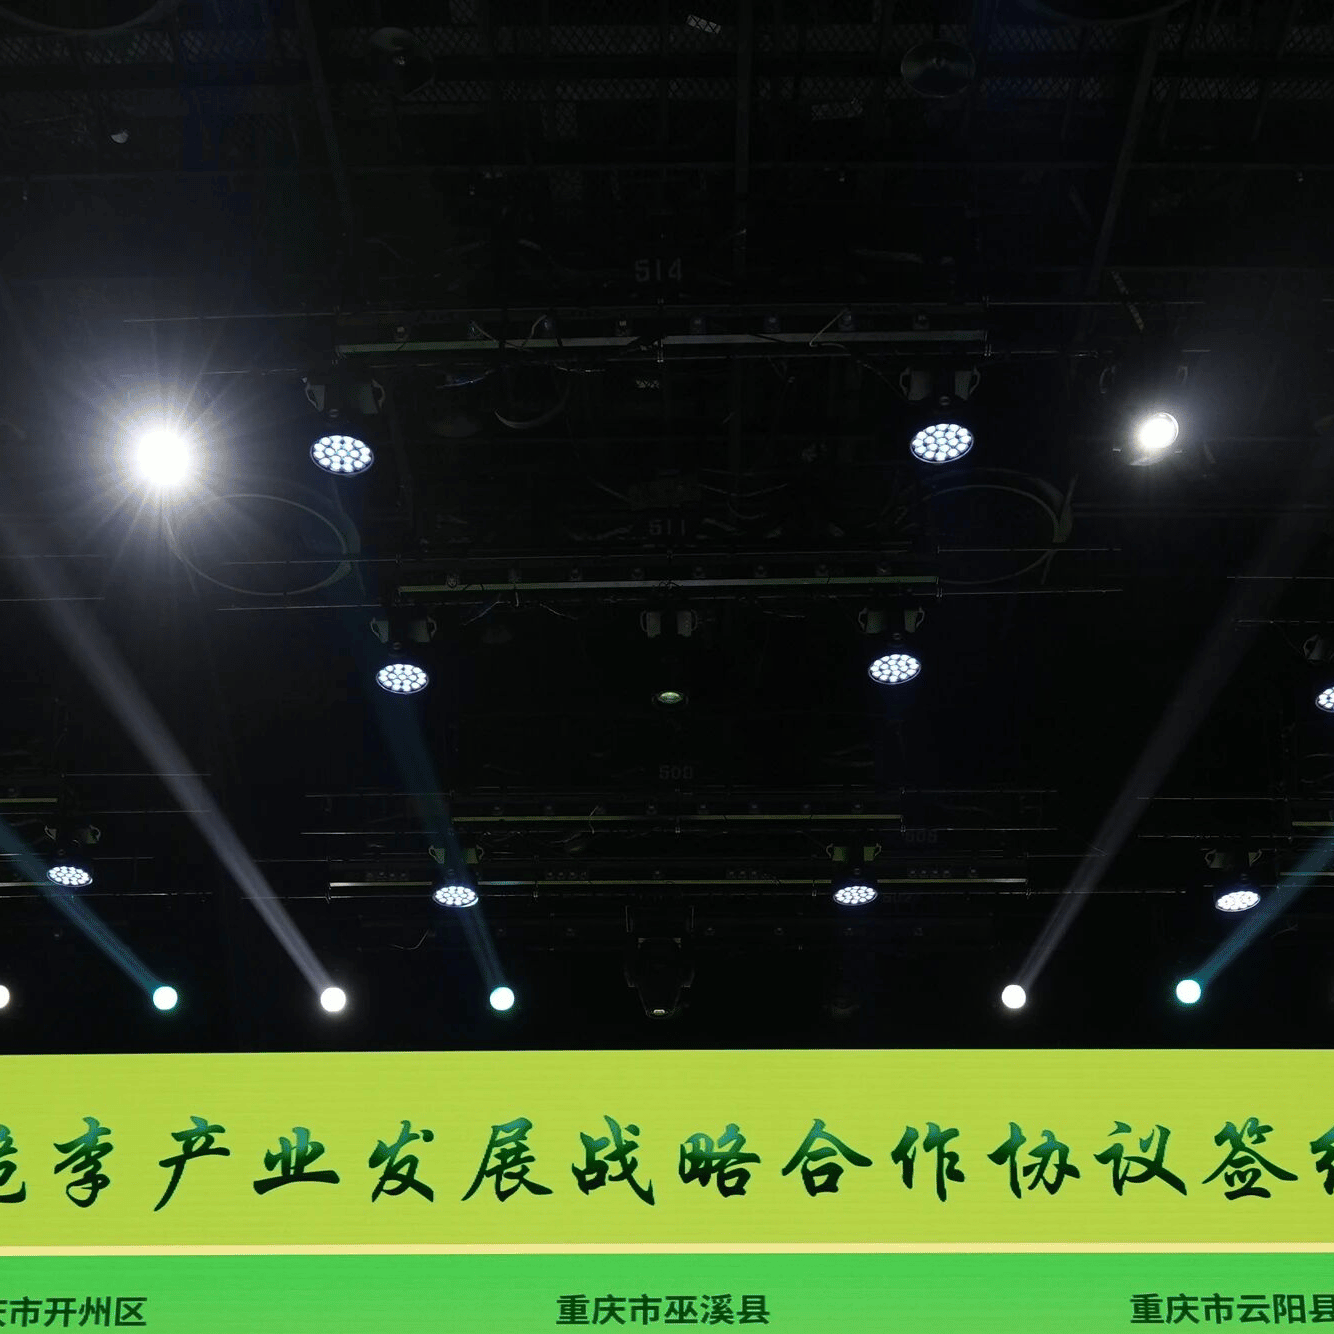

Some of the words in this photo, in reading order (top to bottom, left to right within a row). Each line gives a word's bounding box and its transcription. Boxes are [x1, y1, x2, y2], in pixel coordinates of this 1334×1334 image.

[634, 257, 683, 283] 514
[556, 1293, 770, 1325] 重庆市巫溪县
